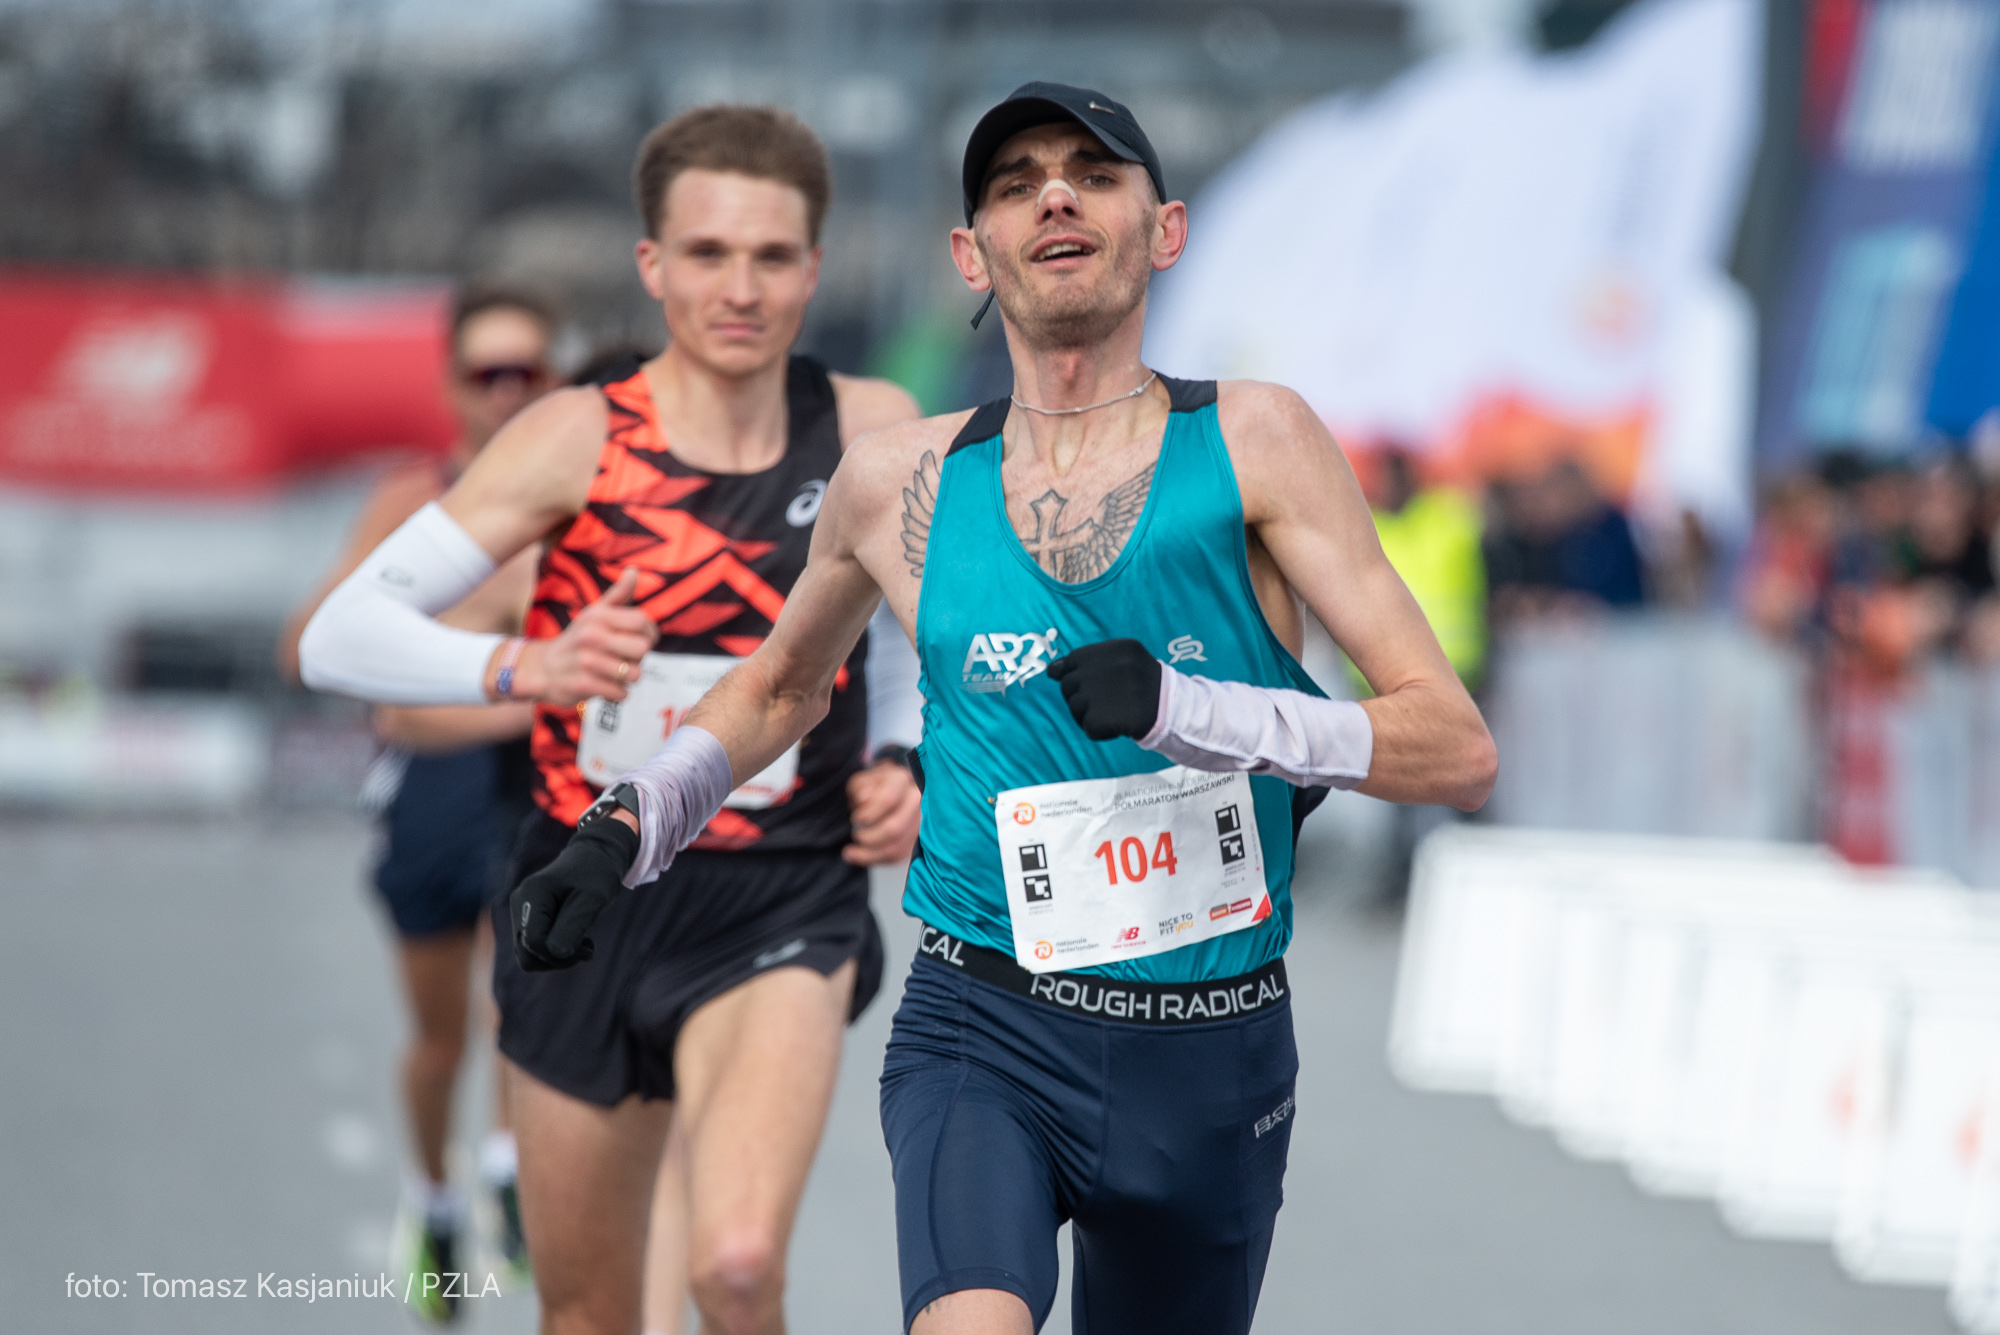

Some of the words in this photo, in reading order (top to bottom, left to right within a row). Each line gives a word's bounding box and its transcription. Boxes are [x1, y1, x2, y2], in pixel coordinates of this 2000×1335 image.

[1180, 774, 1235, 798] WARSZAWSKI
[1094, 831, 1178, 886] 104
[1158, 917, 1180, 929] NICE
[1181, 912, 1193, 922] TO
[1159, 926, 1174, 936] FIT
[1175, 920, 1194, 936] you
[1055, 937, 1088, 948] nationale
[1057, 943, 1099, 955] nederlanden
[1030, 974, 1152, 1020] ROUGH
[1159, 974, 1284, 1020] RADICAL
